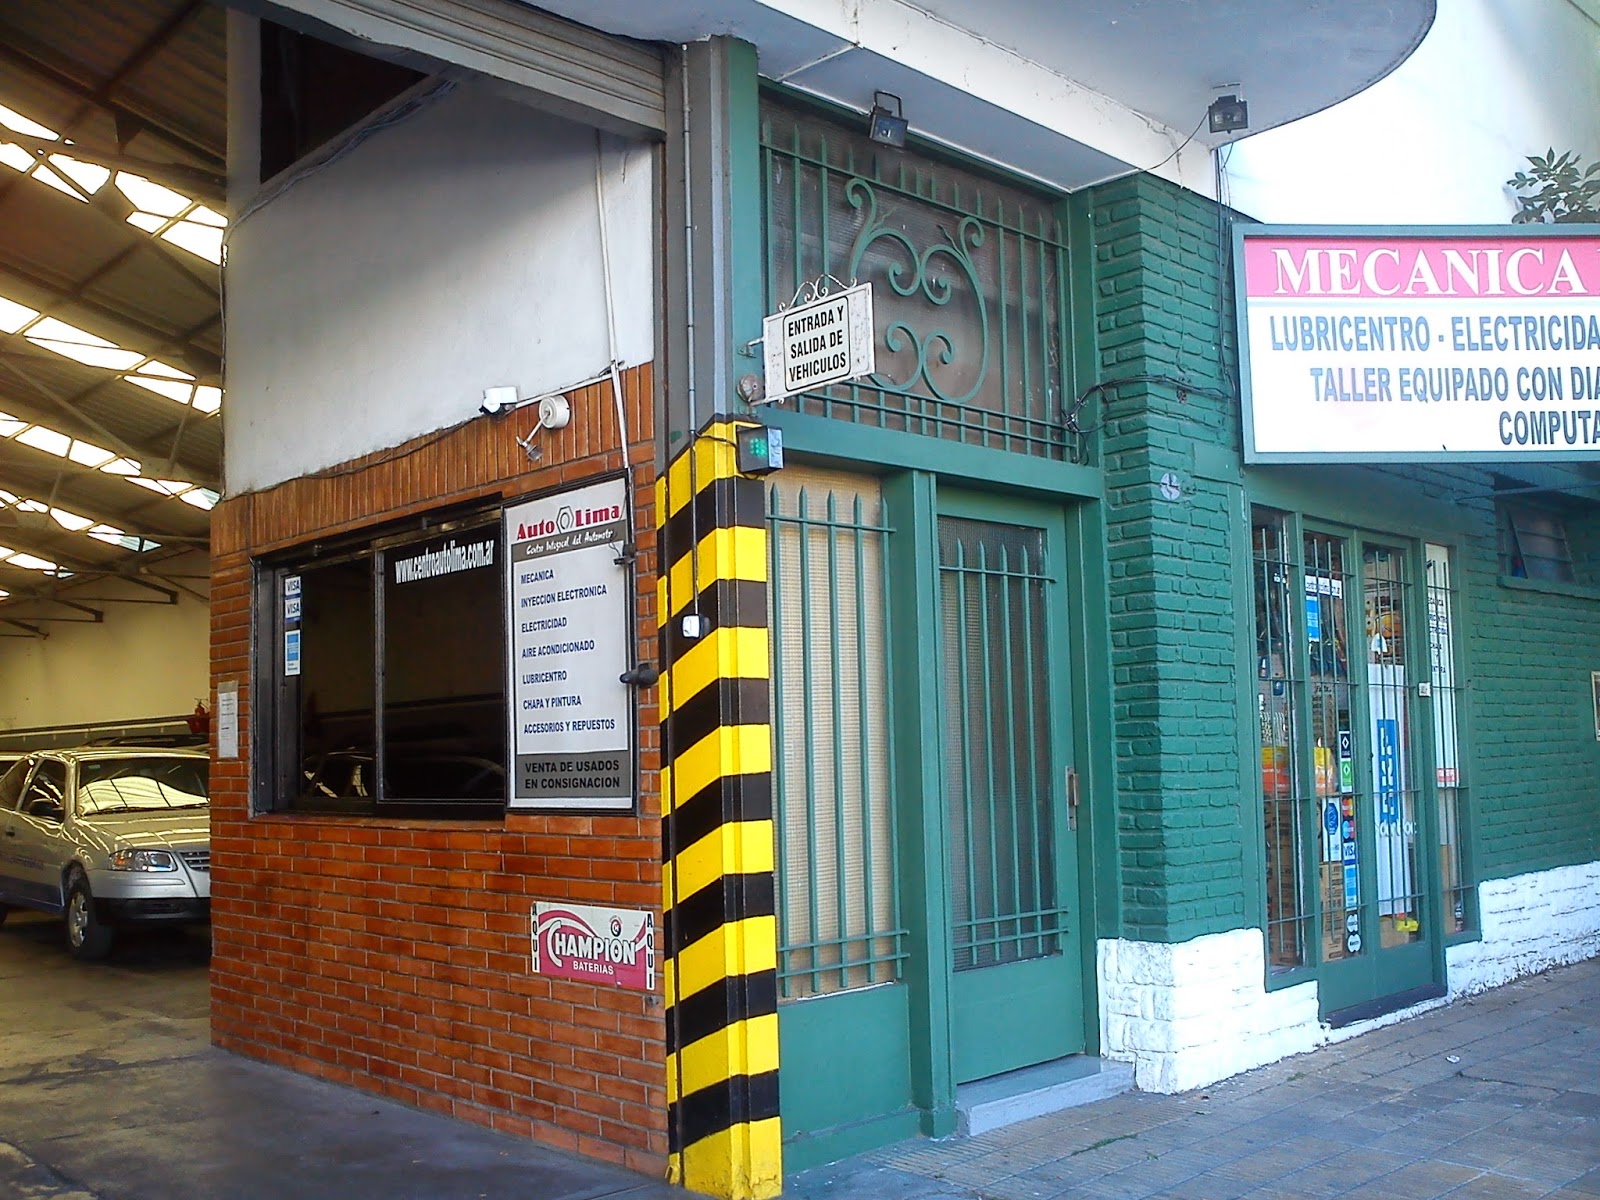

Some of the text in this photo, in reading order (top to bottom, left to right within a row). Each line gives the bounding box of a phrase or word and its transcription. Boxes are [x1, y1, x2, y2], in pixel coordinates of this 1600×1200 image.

[1272, 248, 1588, 296] MECANICA
[788, 305, 844, 338] ENTRADA Y
[1270, 316, 1430, 351] LUBRICENTRO
[790, 329, 843, 359] SALIDA DE
[789, 351, 846, 382] VEHICULOS
[1310, 367, 1392, 401] TALLER
[1400, 367, 1509, 403] EQUIPADO
[1517, 366, 1563, 400] CON
[517, 505, 620, 541] Auto Lima
[395, 540, 494, 584] www.centroautolima.com.ar
[287, 580, 300, 592] VISA
[520, 569, 554, 585] MECANICA
[521, 584, 607, 608] INYECCION ELECTRONICA
[287, 602, 300, 615] VISA
[521, 616, 568, 634] ELECTRICIDAD
[522, 639, 595, 659] AIRE ACONDICIONADO
[523, 670, 567, 685] LUBRICENTRO
[523, 695, 582, 710] CHAPA Y PINTURA
[523, 719, 615, 735] ACCESORIOS Y REPUESTOS
[525, 759, 619, 773] VENTA DE USADOS
[525, 777, 620, 789] EN CONSIGNACION
[547, 919, 636, 968] CHAMPION
[573, 961, 614, 975] BATERIAS
